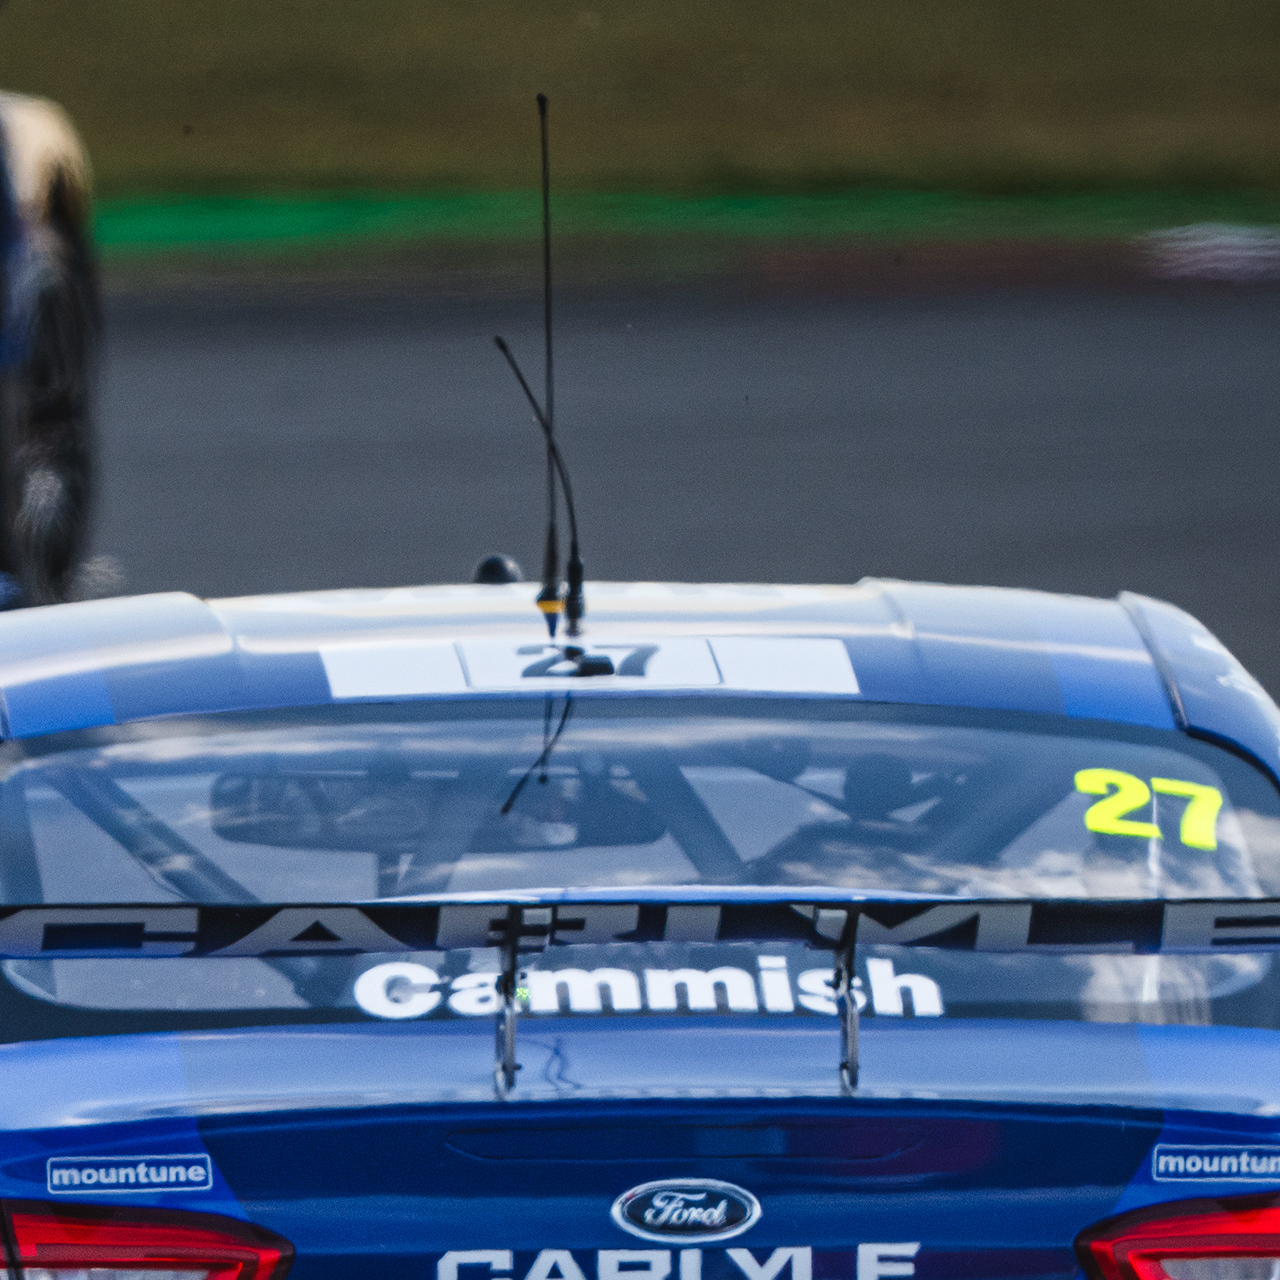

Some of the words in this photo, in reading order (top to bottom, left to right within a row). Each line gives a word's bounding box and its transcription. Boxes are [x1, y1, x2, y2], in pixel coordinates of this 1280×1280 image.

[1075, 767, 1223, 850] 27
[353, 956, 944, 1019] Cammish
[51, 1160, 207, 1187] mountune
[642, 1191, 727, 1227] Ford
